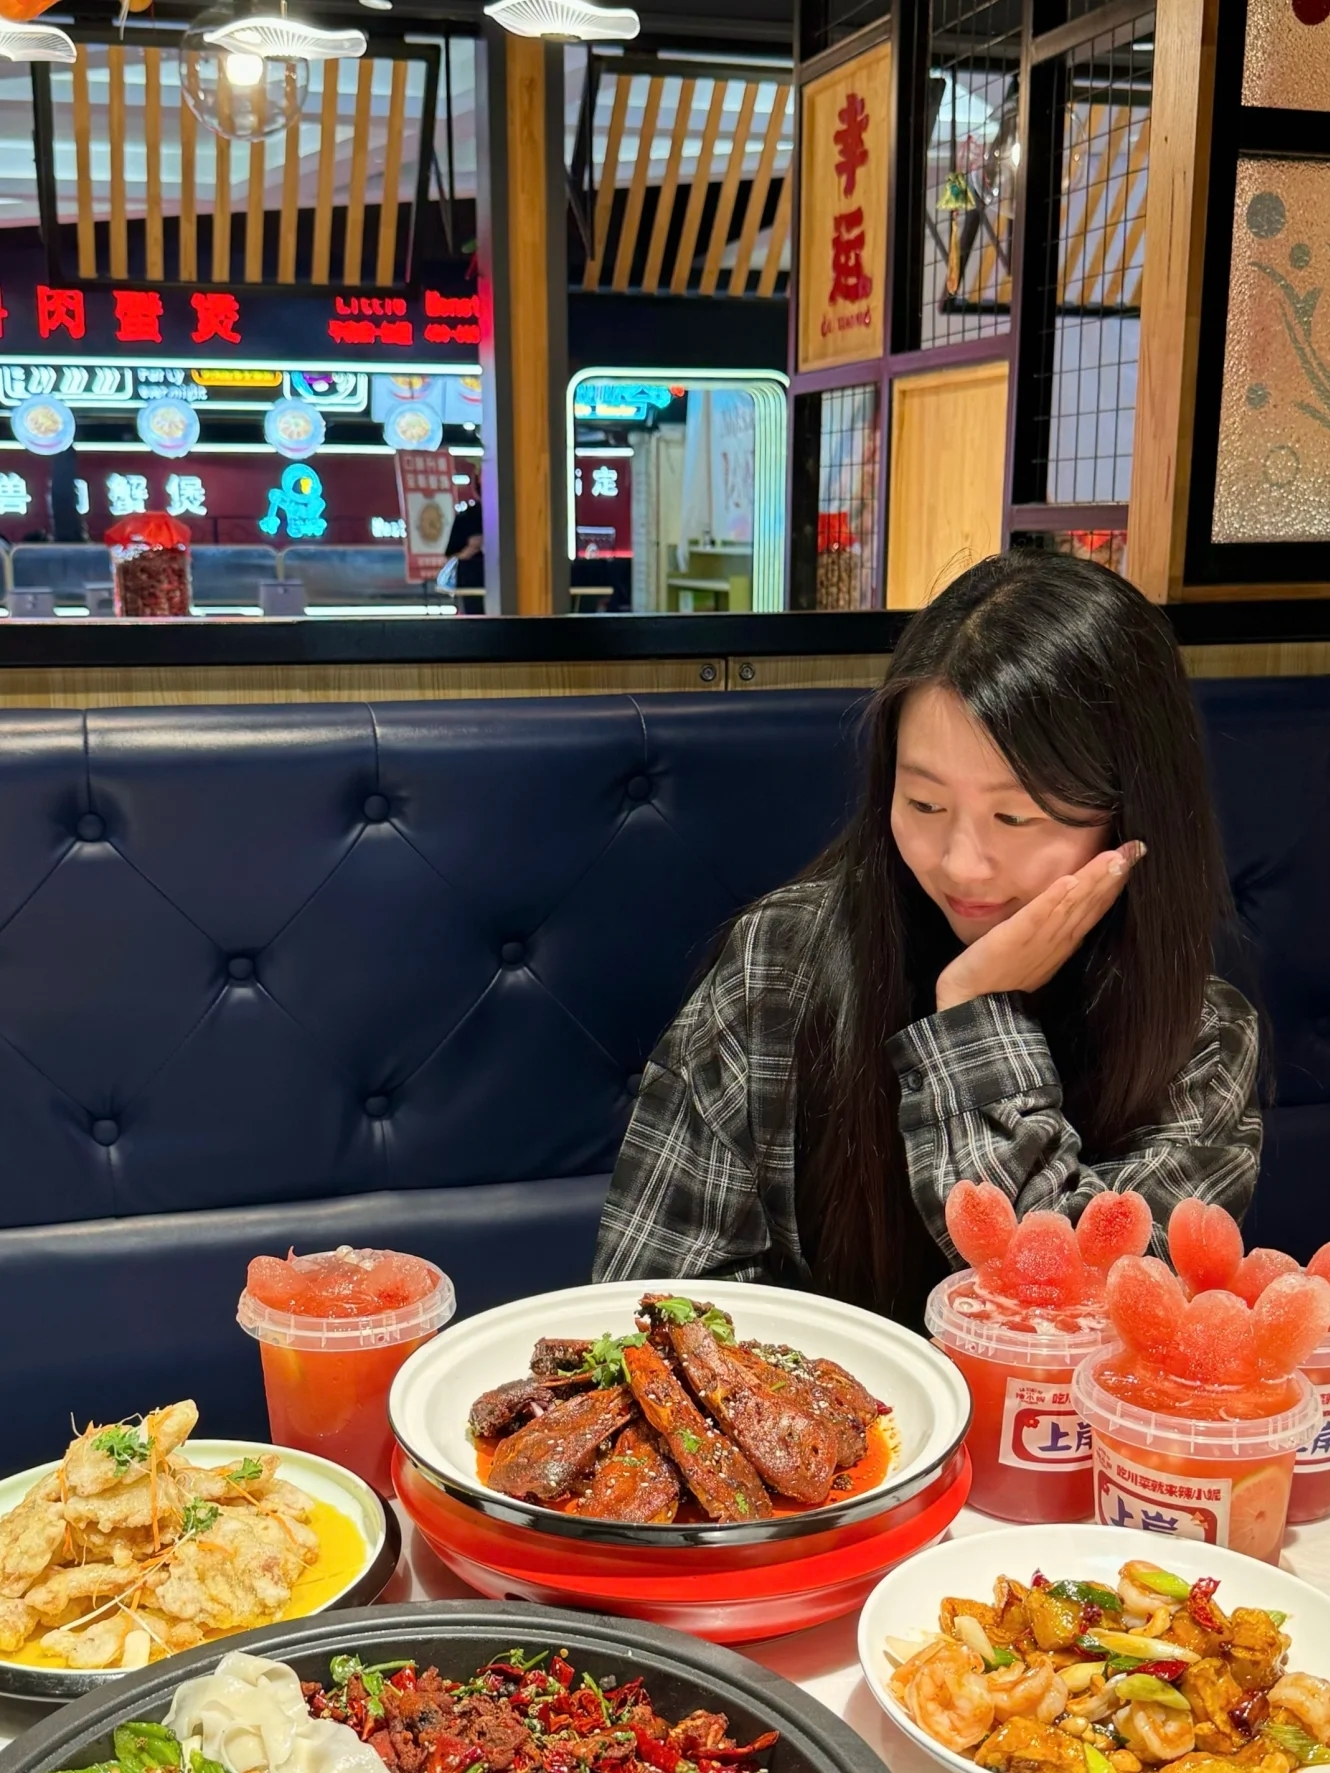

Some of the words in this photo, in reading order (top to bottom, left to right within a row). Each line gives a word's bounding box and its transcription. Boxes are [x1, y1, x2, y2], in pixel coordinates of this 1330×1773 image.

[1116, 1464, 1221, 1502] 吃川菜就来辣小妮
